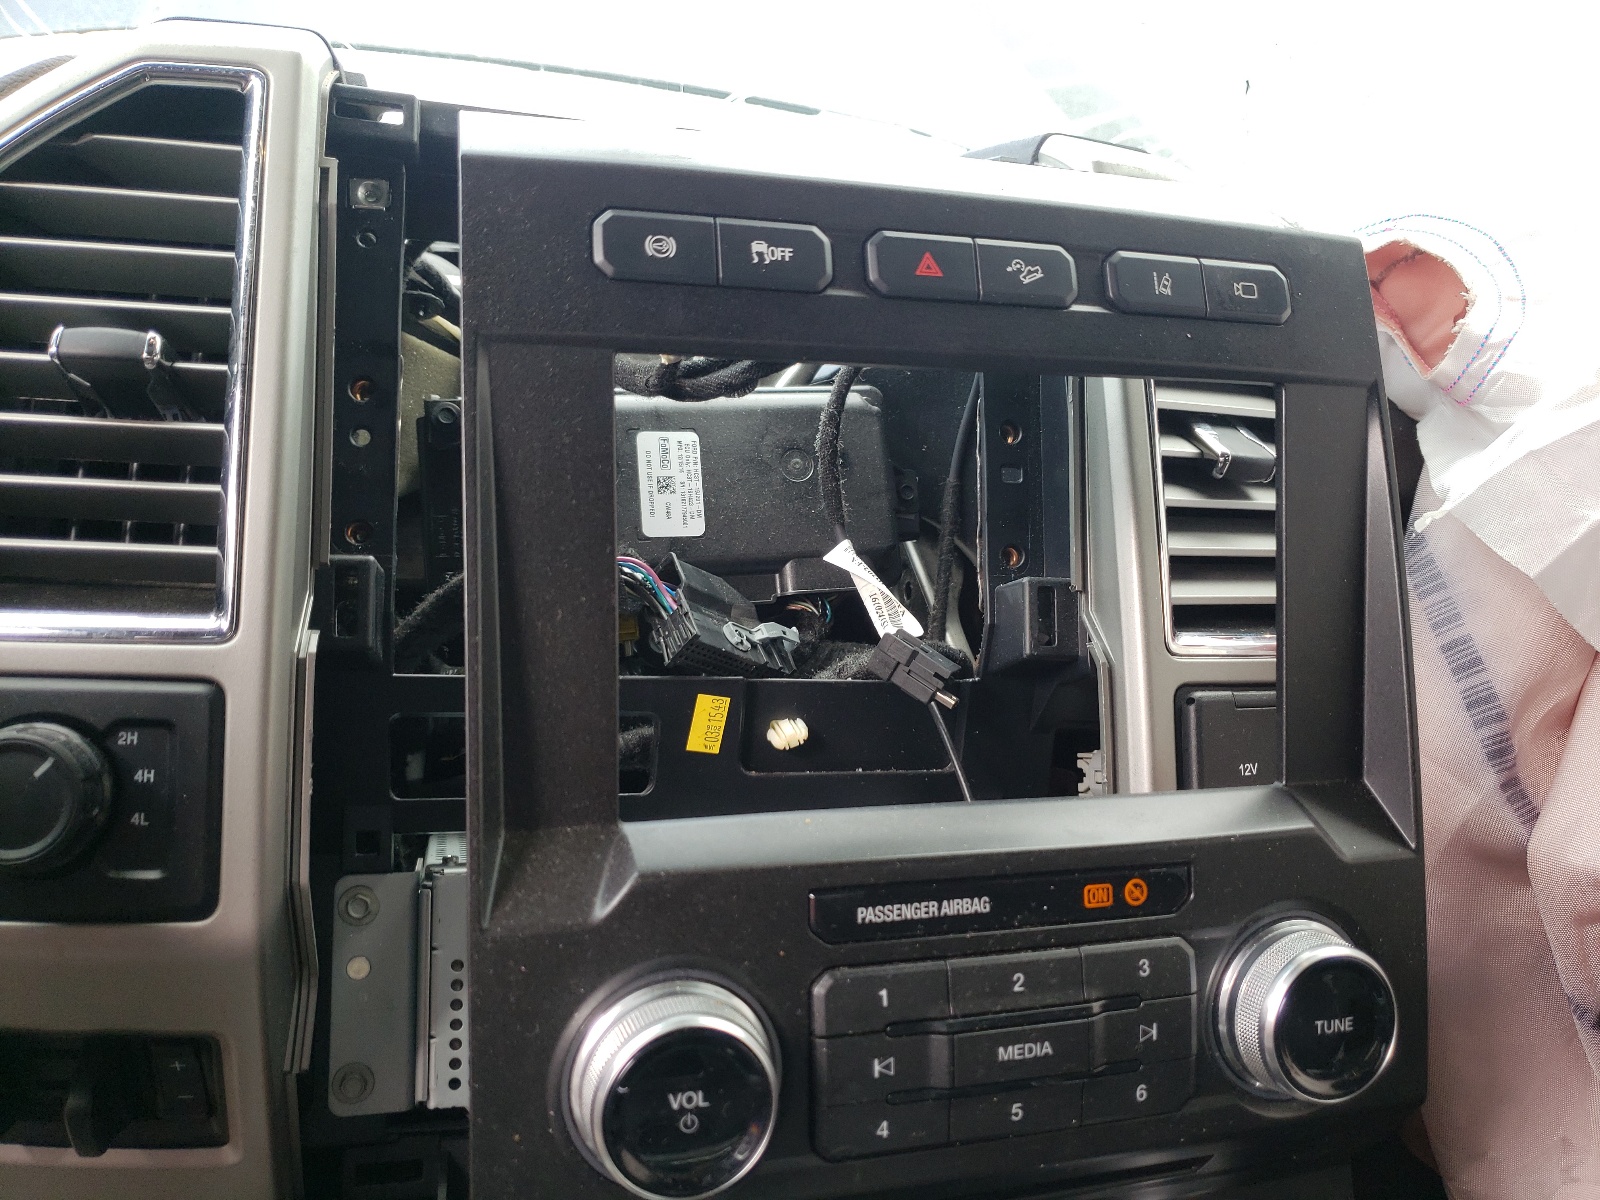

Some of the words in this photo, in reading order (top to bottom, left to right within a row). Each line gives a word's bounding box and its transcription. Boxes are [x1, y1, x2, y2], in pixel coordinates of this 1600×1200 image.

[767, 246, 794, 262] OFF
[645, 450, 652, 459] DO
[660, 438, 670, 469] FoMoCo
[648, 490, 656, 518] DROPPED!
[117, 731, 139, 746] 2H
[133, 769, 155, 783] 4H
[1239, 762, 1258, 776] 12V
[130, 812, 149, 826] 4L
[857, 900, 939, 924] PASSENGER
[940, 896, 991, 917] AIRBAG
[1138, 958, 1150, 978] 3
[1012, 972, 1025, 993] 2
[877, 988, 889, 1008] 1
[1314, 1016, 1354, 1035] TUNE
[998, 1040, 1053, 1061] MEDIA
[667, 1089, 711, 1111] VOL
[1135, 1084, 1148, 1101] 6
[1010, 1102, 1024, 1121] 5
[876, 1119, 890, 1139] 4
